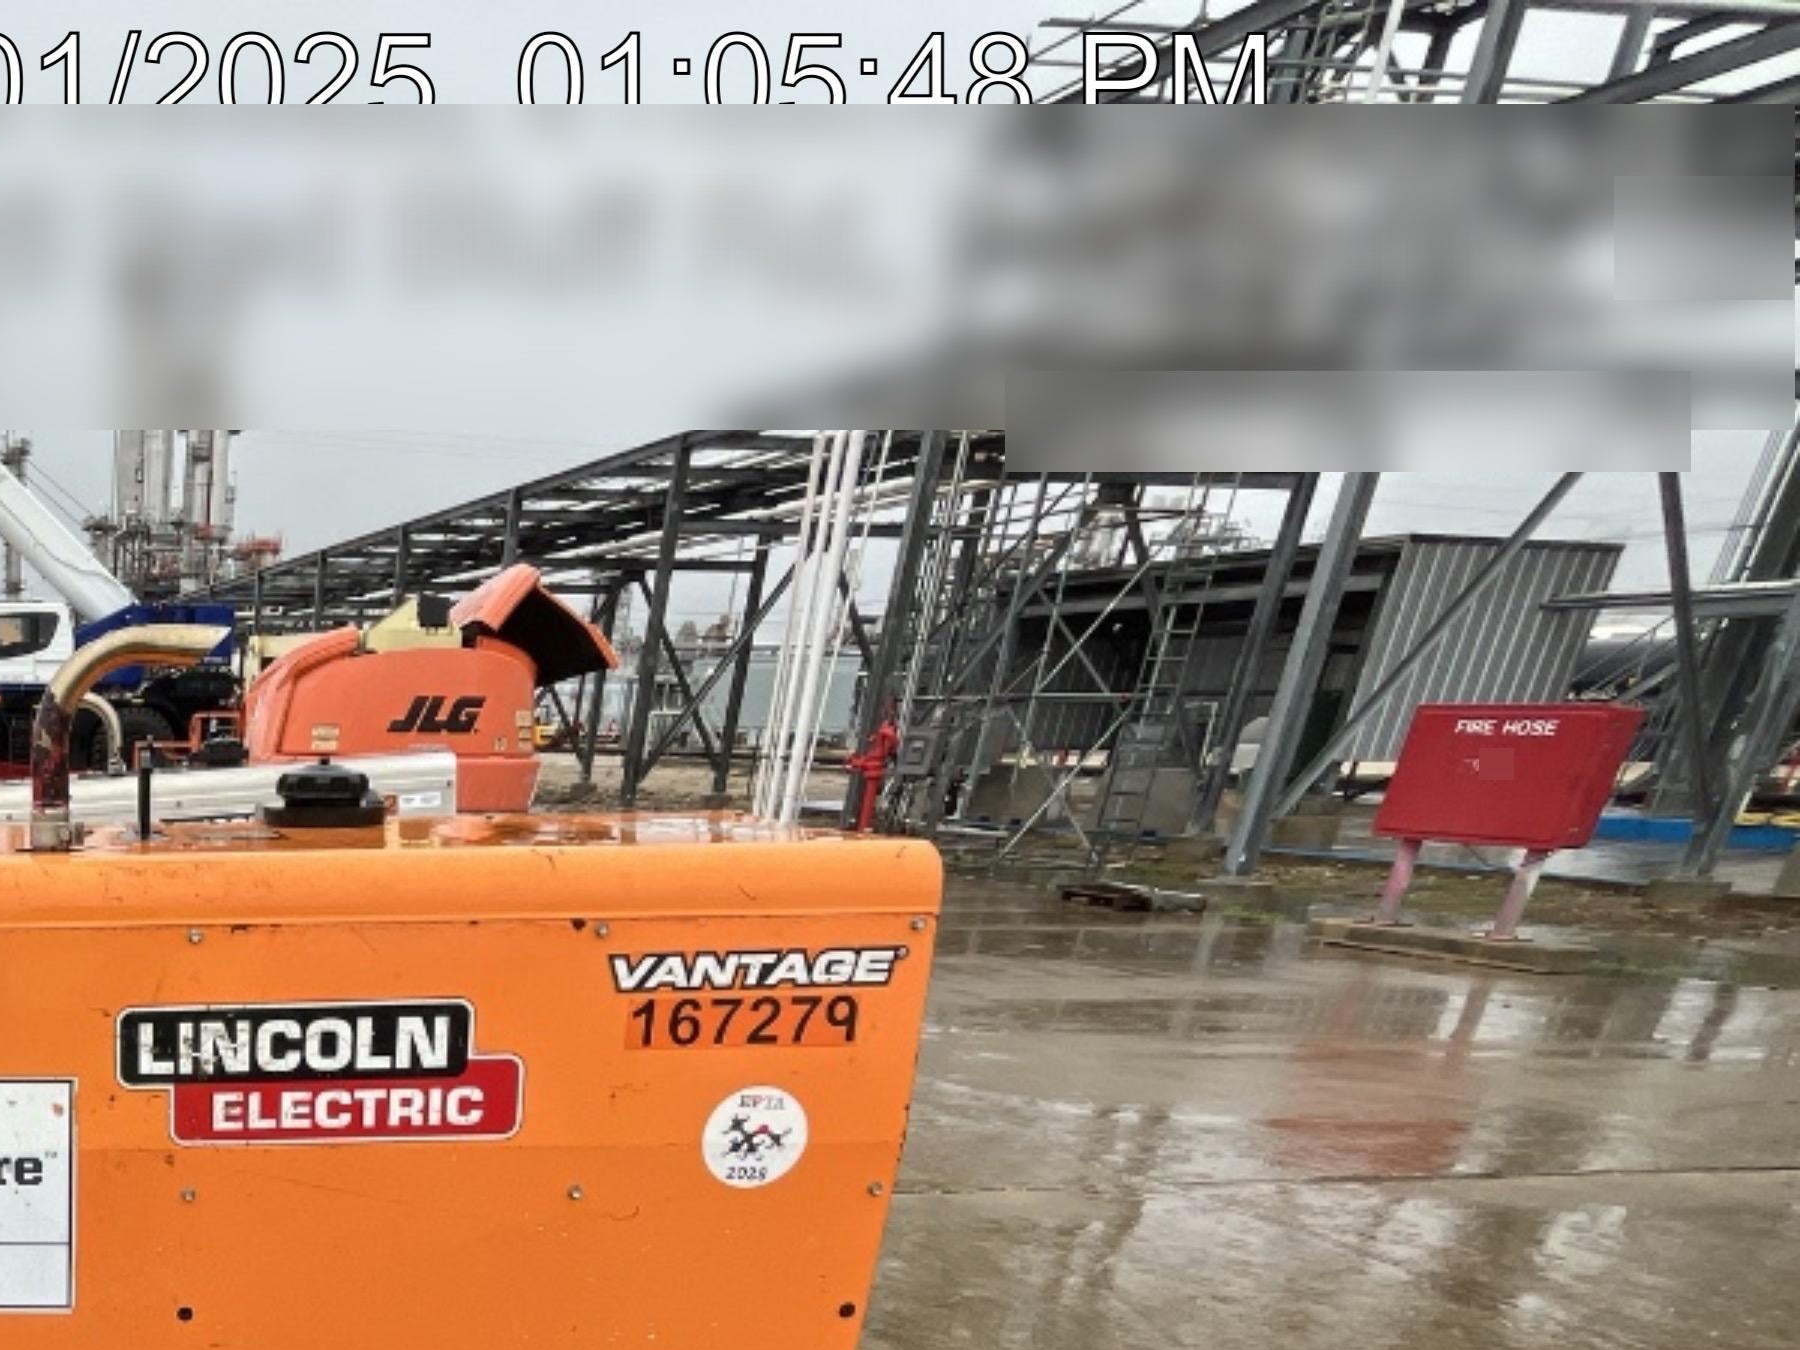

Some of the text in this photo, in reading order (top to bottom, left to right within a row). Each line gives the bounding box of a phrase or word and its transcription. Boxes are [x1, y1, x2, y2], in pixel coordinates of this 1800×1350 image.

[387, 695, 487, 732] JLG
[1454, 719, 1560, 736] FIRE HOSE
[610, 948, 897, 990] VANTAGE
[632, 995, 859, 1047] 167279
[137, 1015, 451, 1076] LINCOLN
[212, 1086, 484, 1132] ELECTRIC
